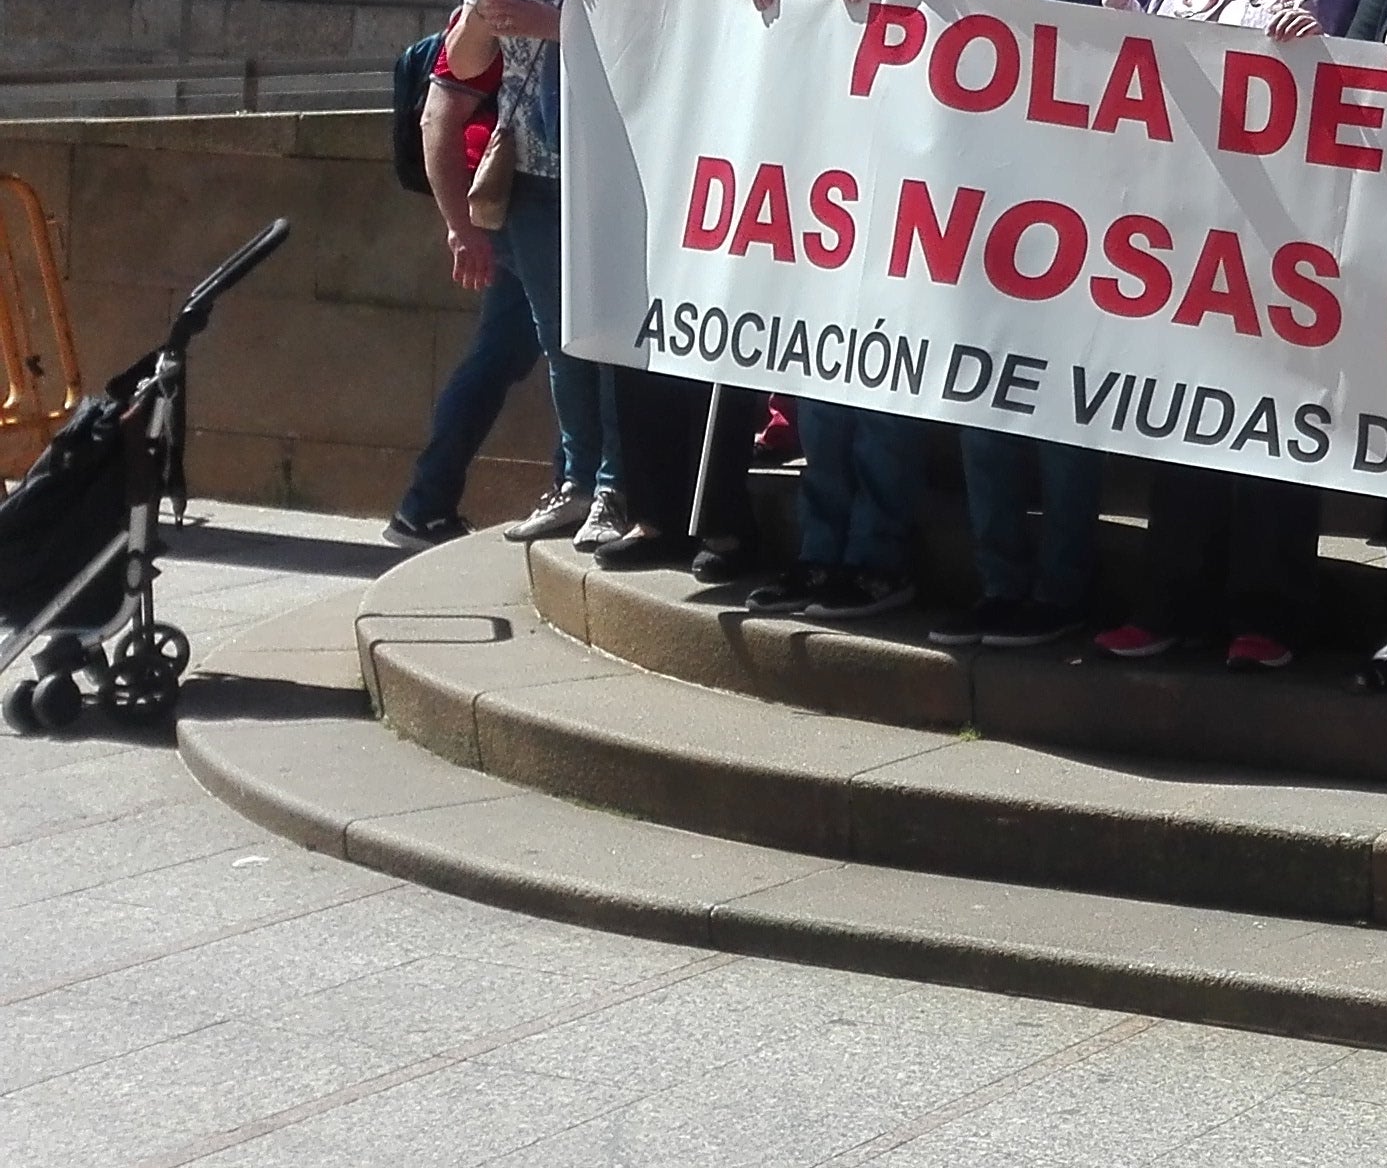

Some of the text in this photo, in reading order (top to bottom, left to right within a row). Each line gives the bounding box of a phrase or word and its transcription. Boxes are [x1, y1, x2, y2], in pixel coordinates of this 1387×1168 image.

[850, 2, 1173, 143] POLA
[682, 156, 859, 270] DAS
[888, 181, 1341, 348] NOSAS
[635, 298, 929, 397] ASOCIACIÓN
[942, 343, 1048, 415] DE
[1069, 365, 1333, 465] VIUDAS
